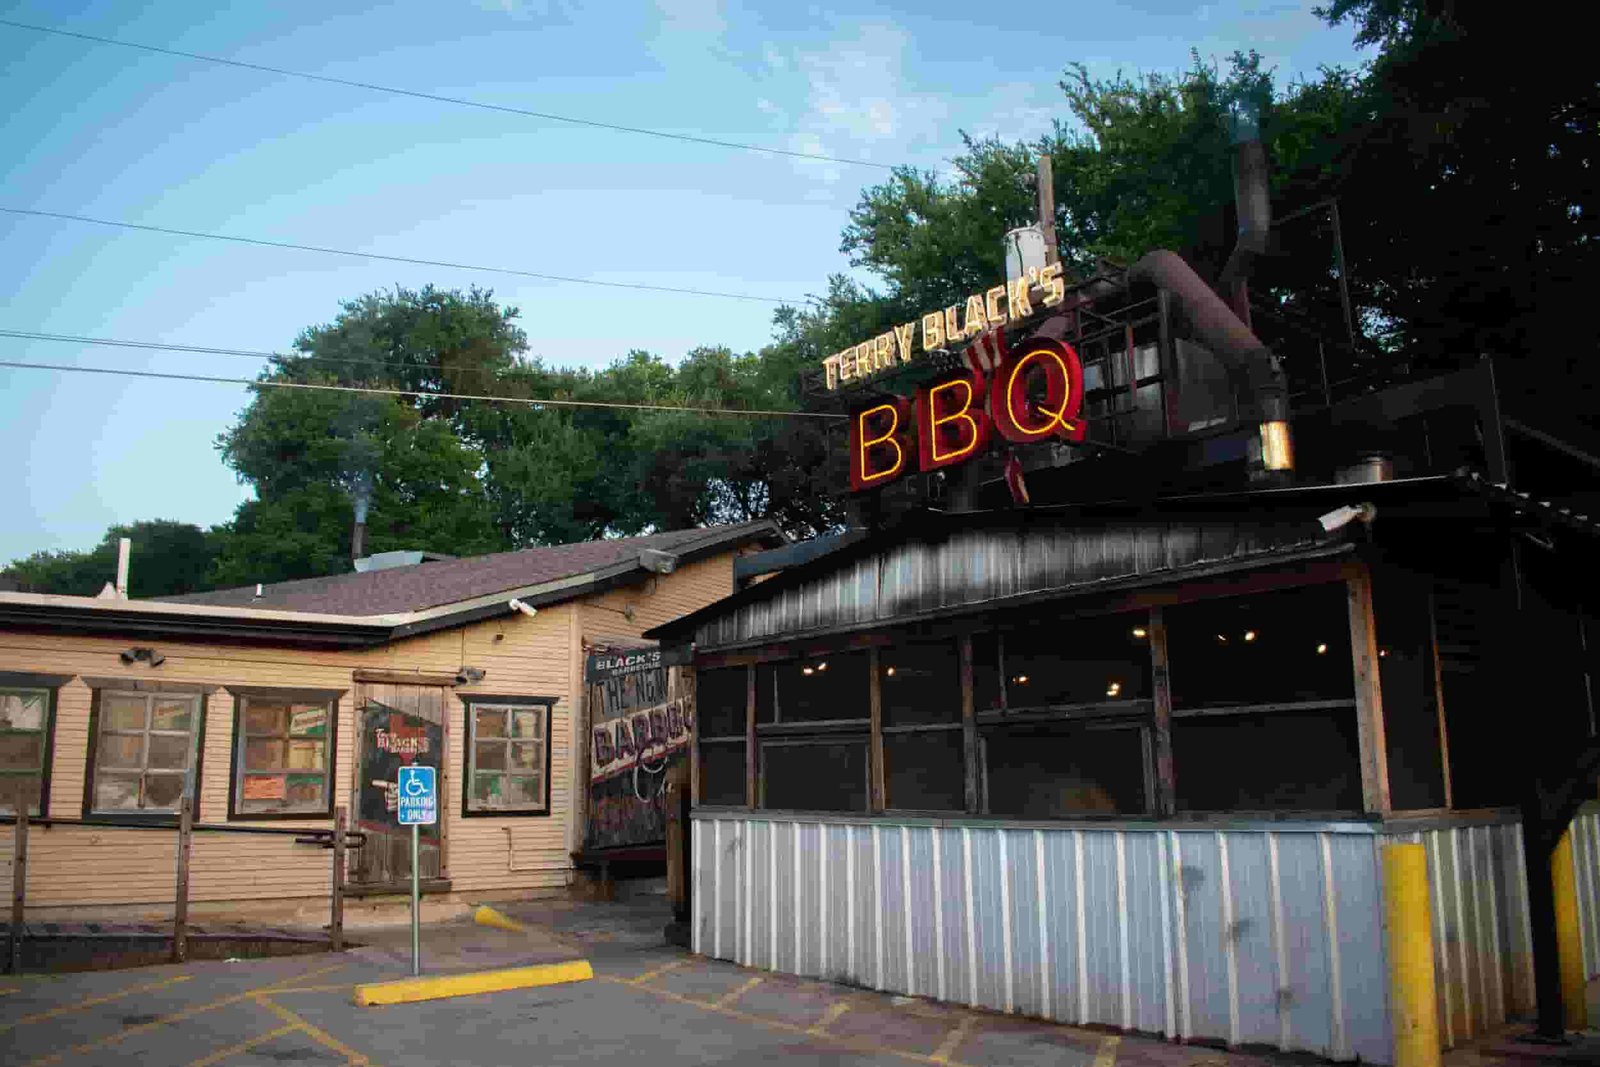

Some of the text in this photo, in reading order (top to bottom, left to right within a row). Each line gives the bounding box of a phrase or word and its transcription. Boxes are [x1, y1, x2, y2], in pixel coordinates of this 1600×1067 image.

[822, 261, 1066, 390] TERRY BLACK'S
[850, 337, 1087, 492] BBQ
[596, 651, 661, 671] BLACK'S
[401, 796, 434, 808] PARKING
[407, 809, 427, 820] ONLY
